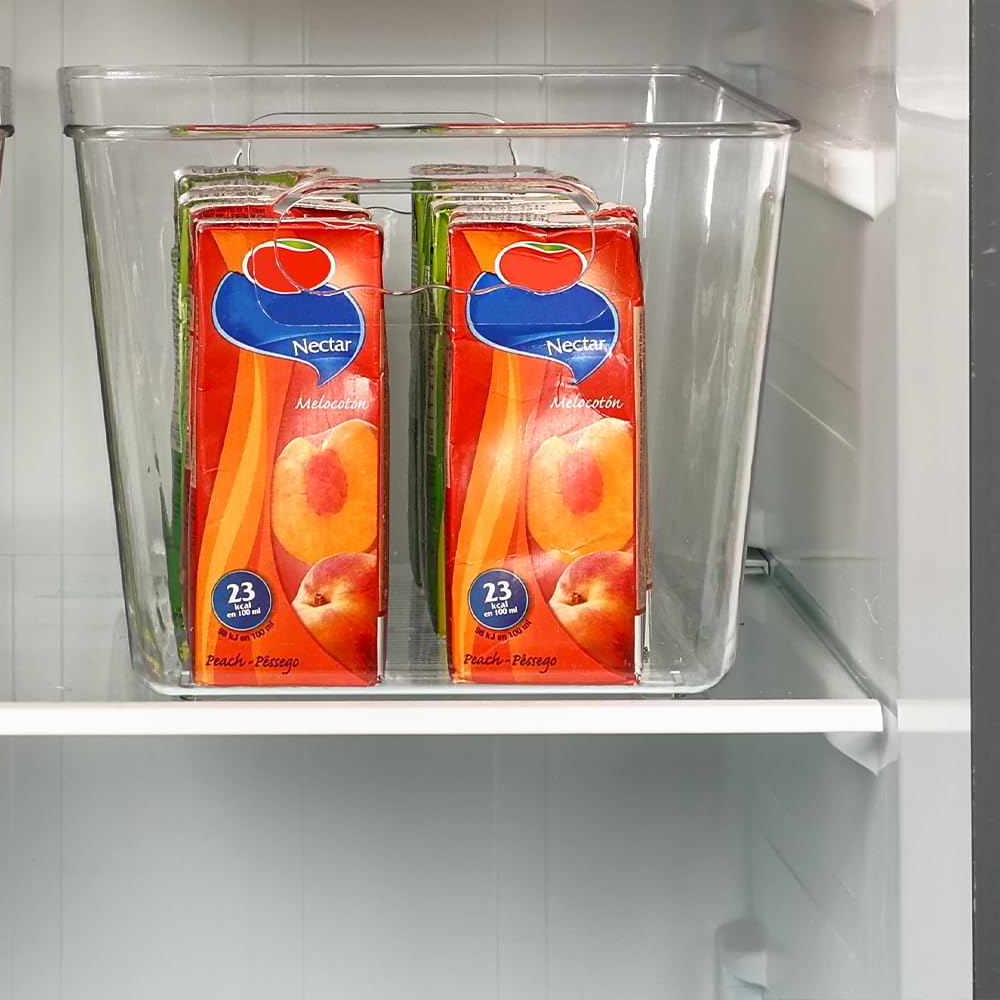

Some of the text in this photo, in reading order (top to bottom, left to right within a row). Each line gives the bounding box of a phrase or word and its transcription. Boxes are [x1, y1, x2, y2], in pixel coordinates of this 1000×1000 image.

[292, 336, 352, 356] Nectar
[545, 336, 606, 356] Nectar
[294, 393, 370, 410] Melocotón
[549, 392, 624, 409] Melocotón
[226, 581, 256, 604] 23
[483, 580, 512, 603] 23
[234, 601, 252, 610] kcal
[238, 608, 251, 617] 100
[251, 607, 261, 615] ml
[483, 606, 518, 618] en 100 ml
[491, 600, 509, 610] kcal
[240, 634, 250, 642] en
[251, 628, 266, 640] 100
[265, 620, 275, 632] ml
[508, 627, 522, 638] 100
[522, 619, 532, 631] ml
[205, 653, 246, 668] Peach
[254, 654, 300, 675] Pêssego
[463, 651, 505, 667] Peach
[511, 653, 558, 674] Pêssego
